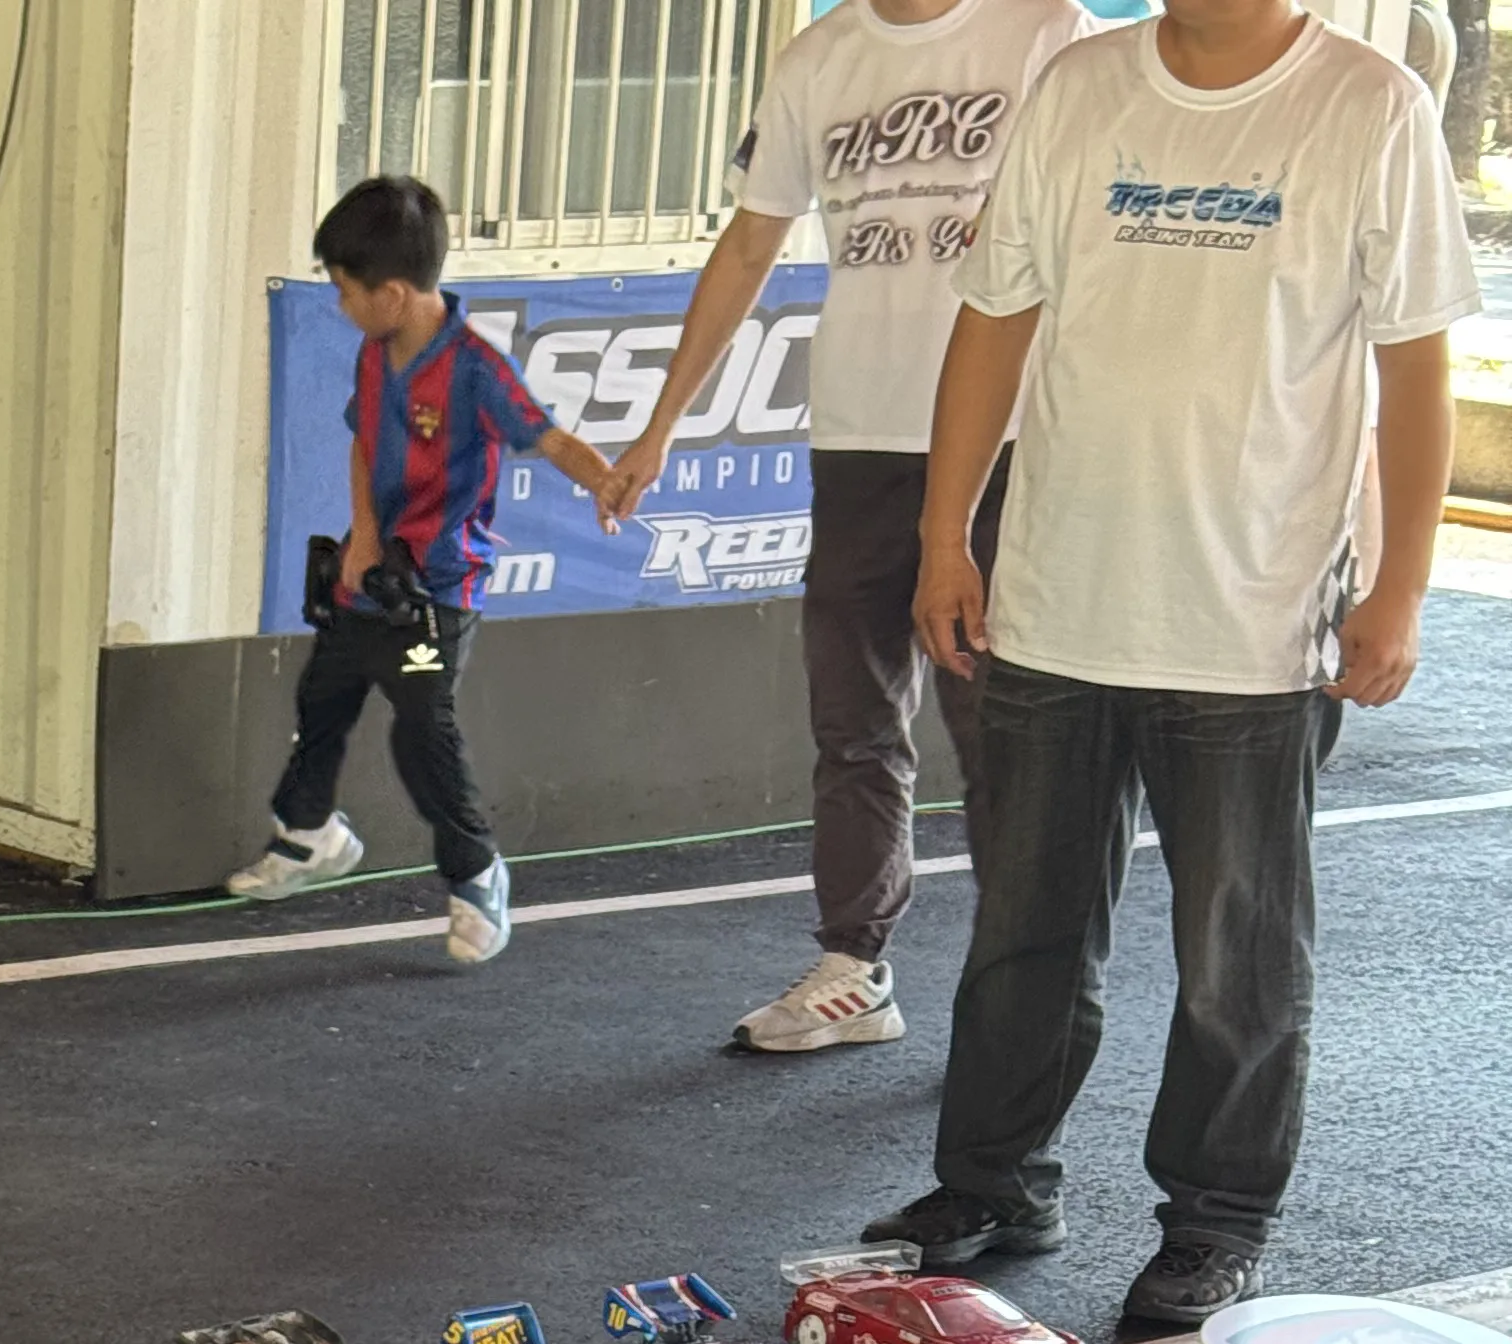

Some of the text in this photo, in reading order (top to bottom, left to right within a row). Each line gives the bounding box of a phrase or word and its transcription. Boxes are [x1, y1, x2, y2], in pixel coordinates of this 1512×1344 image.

[823, 92, 1007, 180] 74RC
[1114, 225, 1256, 250] RACING TEAM
[466, 311, 813, 446] SSOC
[646, 515, 812, 592] REED
[607, 1302, 627, 1331] 10
